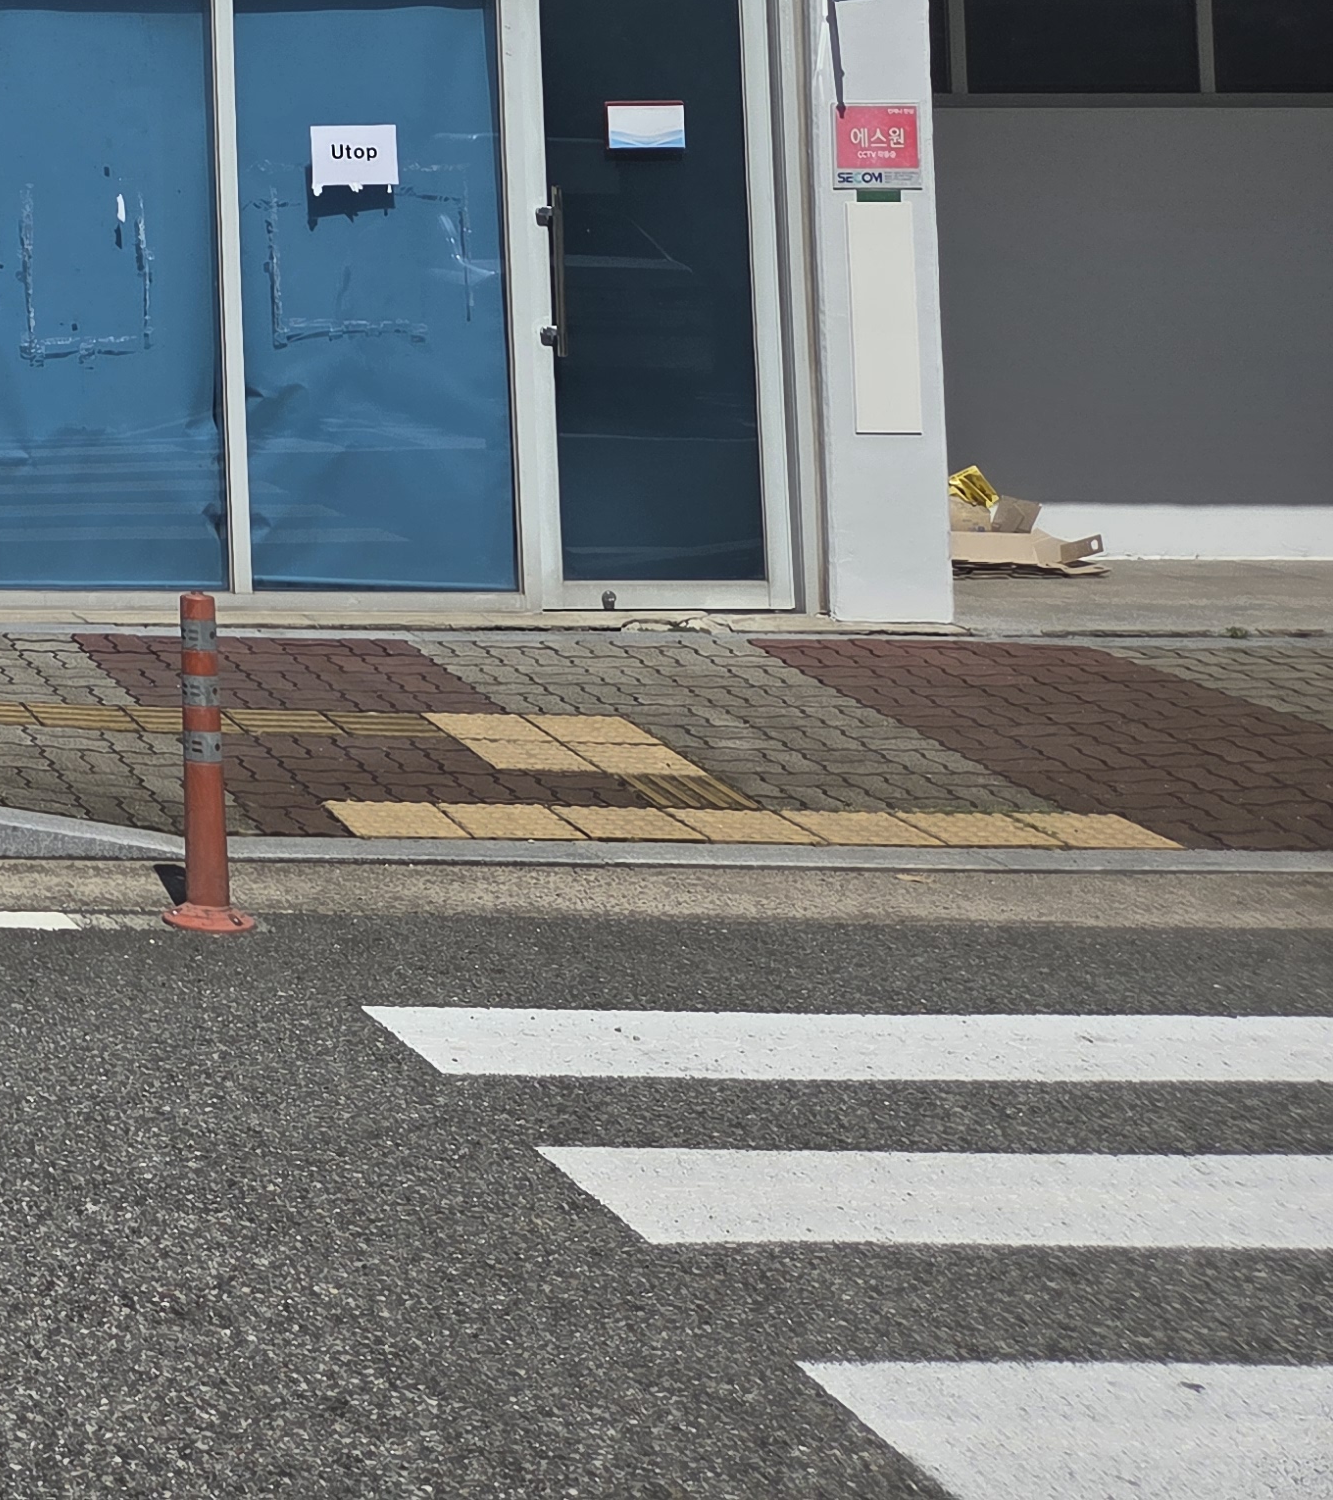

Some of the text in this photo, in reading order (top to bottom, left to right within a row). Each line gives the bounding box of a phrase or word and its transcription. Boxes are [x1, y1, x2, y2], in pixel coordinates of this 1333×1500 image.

[850, 127, 905, 148] 에스원
[330, 143, 378, 162] Utop
[837, 172, 883, 183] SECOM
